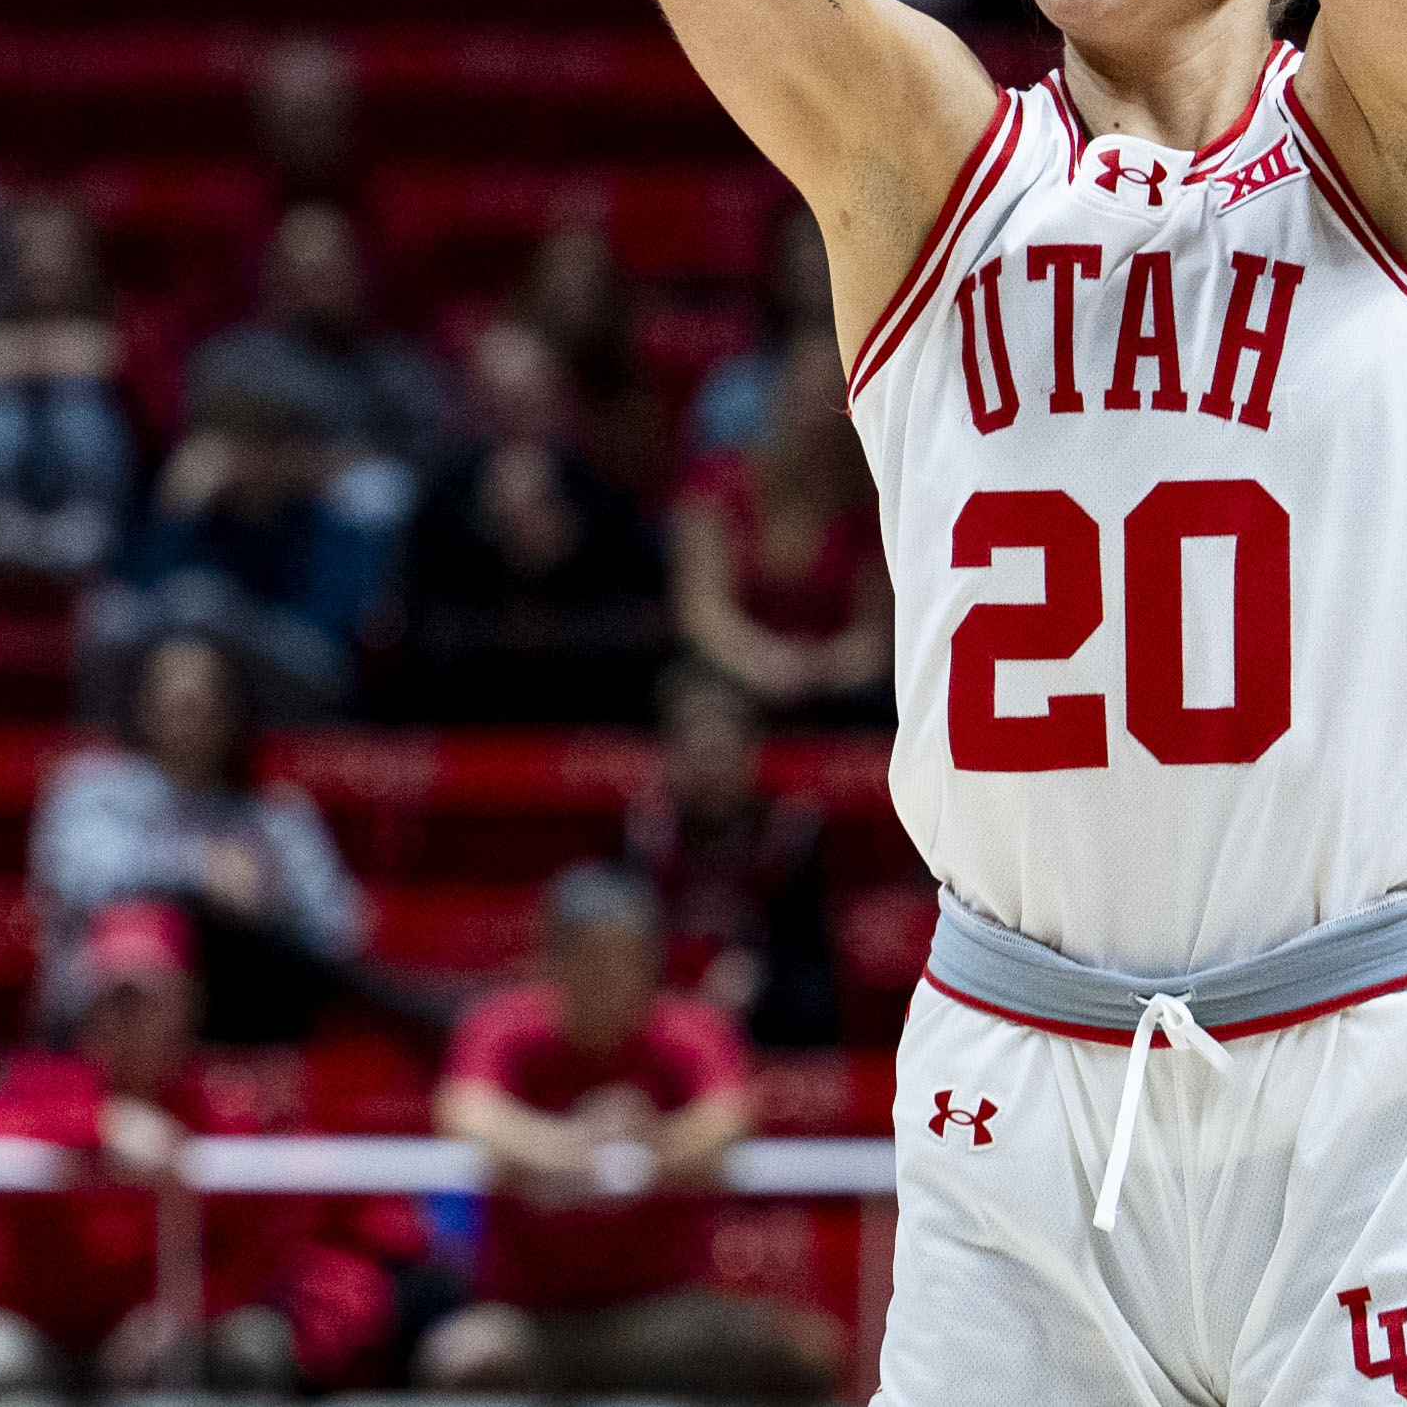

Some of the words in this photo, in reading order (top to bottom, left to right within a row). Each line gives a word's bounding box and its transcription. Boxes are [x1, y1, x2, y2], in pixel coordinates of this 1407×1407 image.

[1214, 132, 1302, 209] XII
[955, 243, 1305, 437] UTAH
[948, 479, 1291, 773] 20
